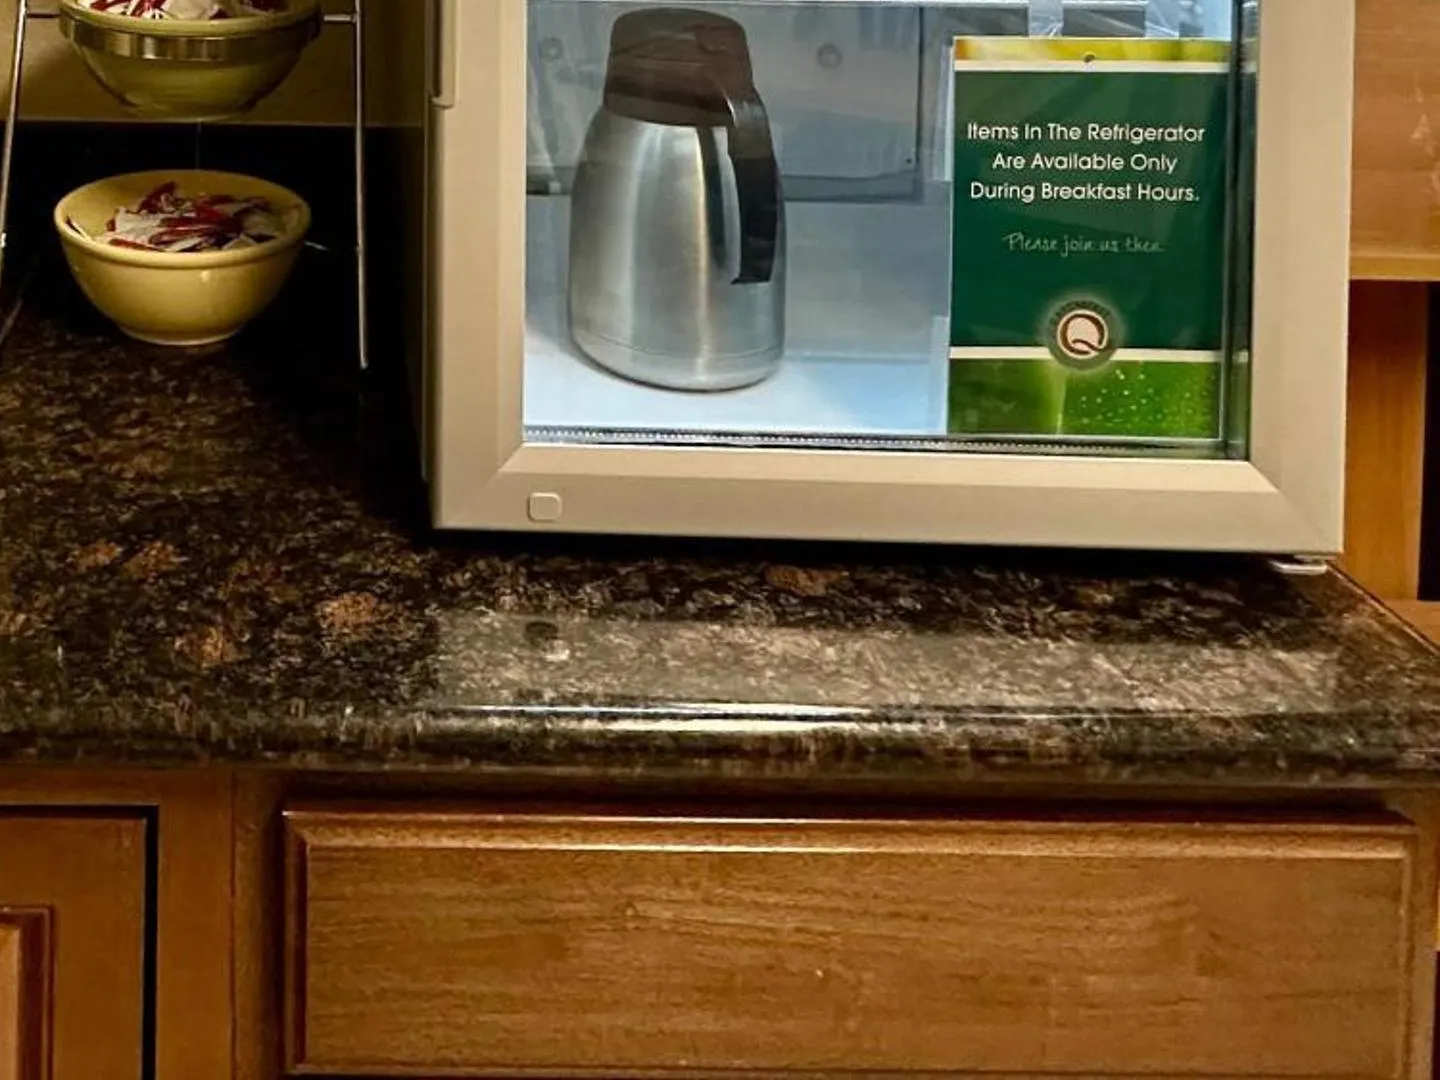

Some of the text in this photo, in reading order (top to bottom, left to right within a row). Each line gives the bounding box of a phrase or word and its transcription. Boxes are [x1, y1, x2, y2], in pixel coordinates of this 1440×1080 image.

[967, 123, 1206, 145] Items In The Refrigerator
[992, 152, 1178, 174] Are Available Only
[970, 182, 1200, 203] During Breakfast Hours.
[1002, 231, 1059, 251] Please
[1060, 234, 1094, 258] join
[1099, 239, 1119, 252] us
